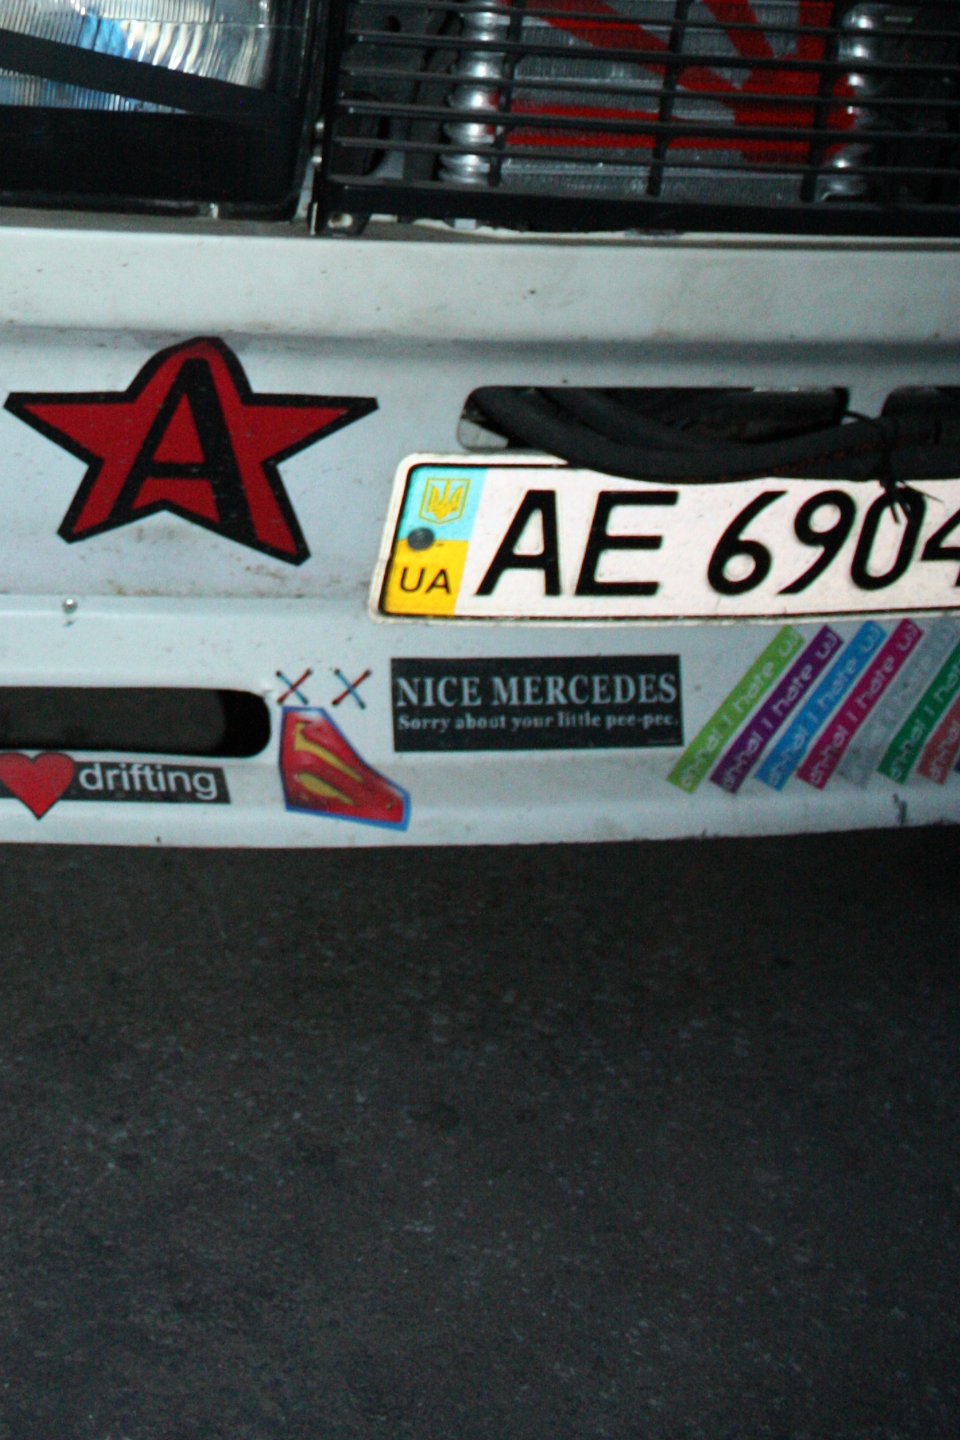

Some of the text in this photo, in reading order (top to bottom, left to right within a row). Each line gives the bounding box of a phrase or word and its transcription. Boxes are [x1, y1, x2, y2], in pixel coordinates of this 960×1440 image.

[107, 358, 259, 540] A
[474, 489, 678, 596] AE
[399, 567, 452, 594] UA
[396, 674, 678, 707] NICE MERCEDES
[398, 714, 449, 733] Sorry
[455, 713, 506, 730] about
[511, 715, 554, 732] your
[557, 711, 601, 728] little
[79, 763, 218, 801] drifting
